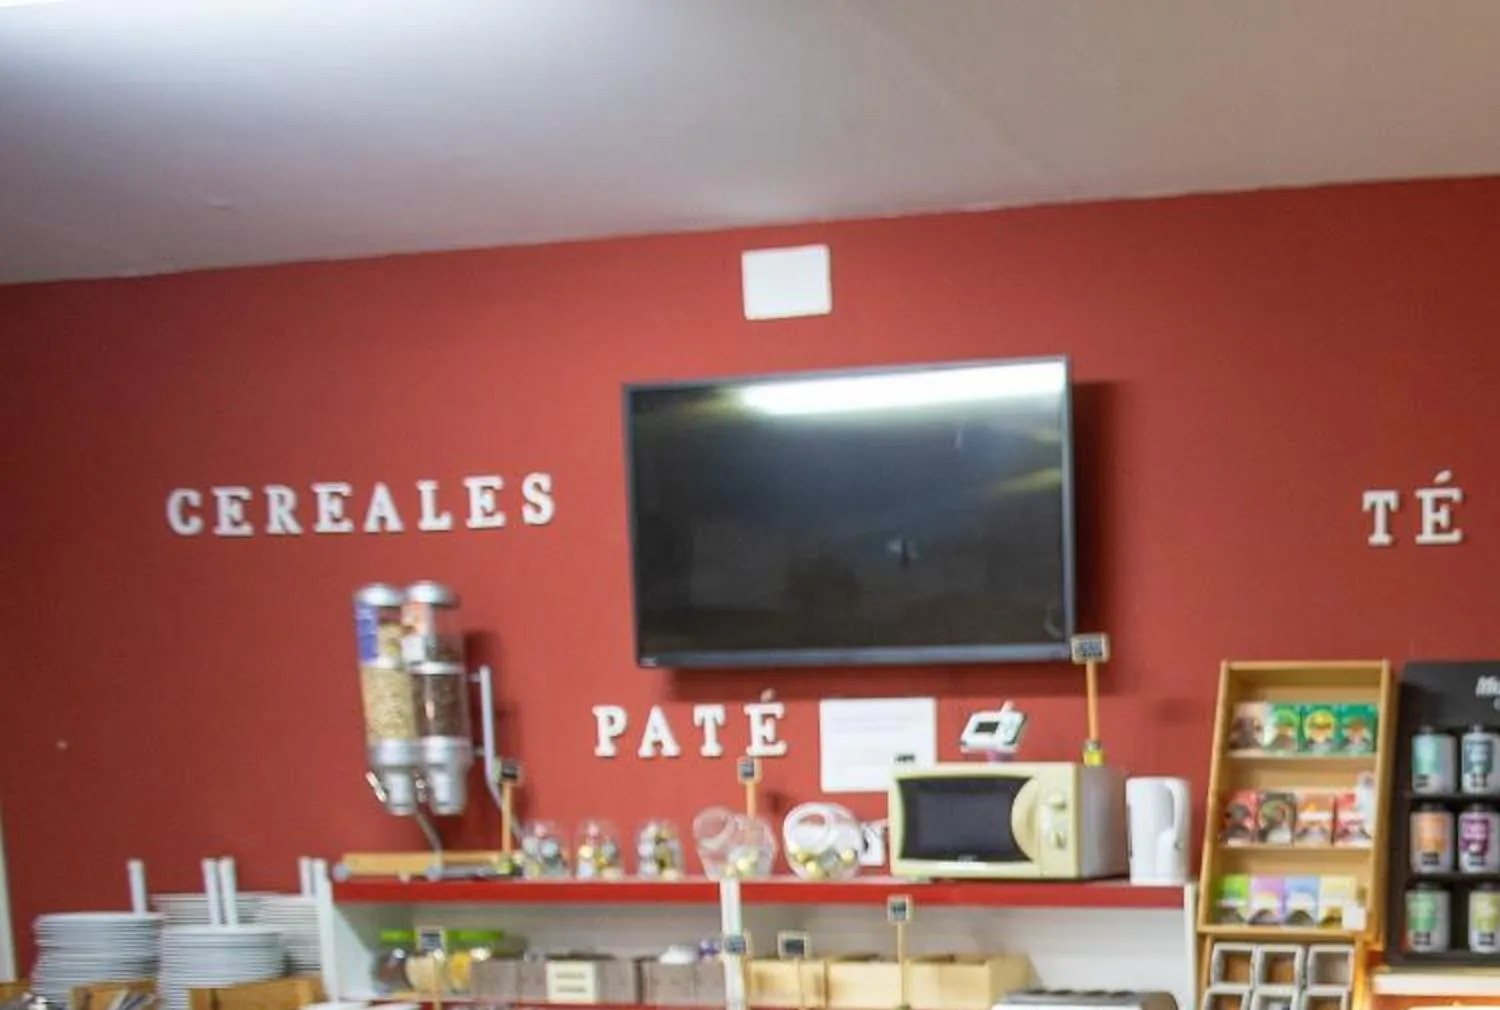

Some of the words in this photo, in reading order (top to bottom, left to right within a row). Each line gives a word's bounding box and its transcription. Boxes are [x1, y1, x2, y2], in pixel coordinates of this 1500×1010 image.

[166, 471, 557, 537] CEREALES
[1362, 469, 1464, 546] TÉ
[591, 688, 789, 757] PATÉ
